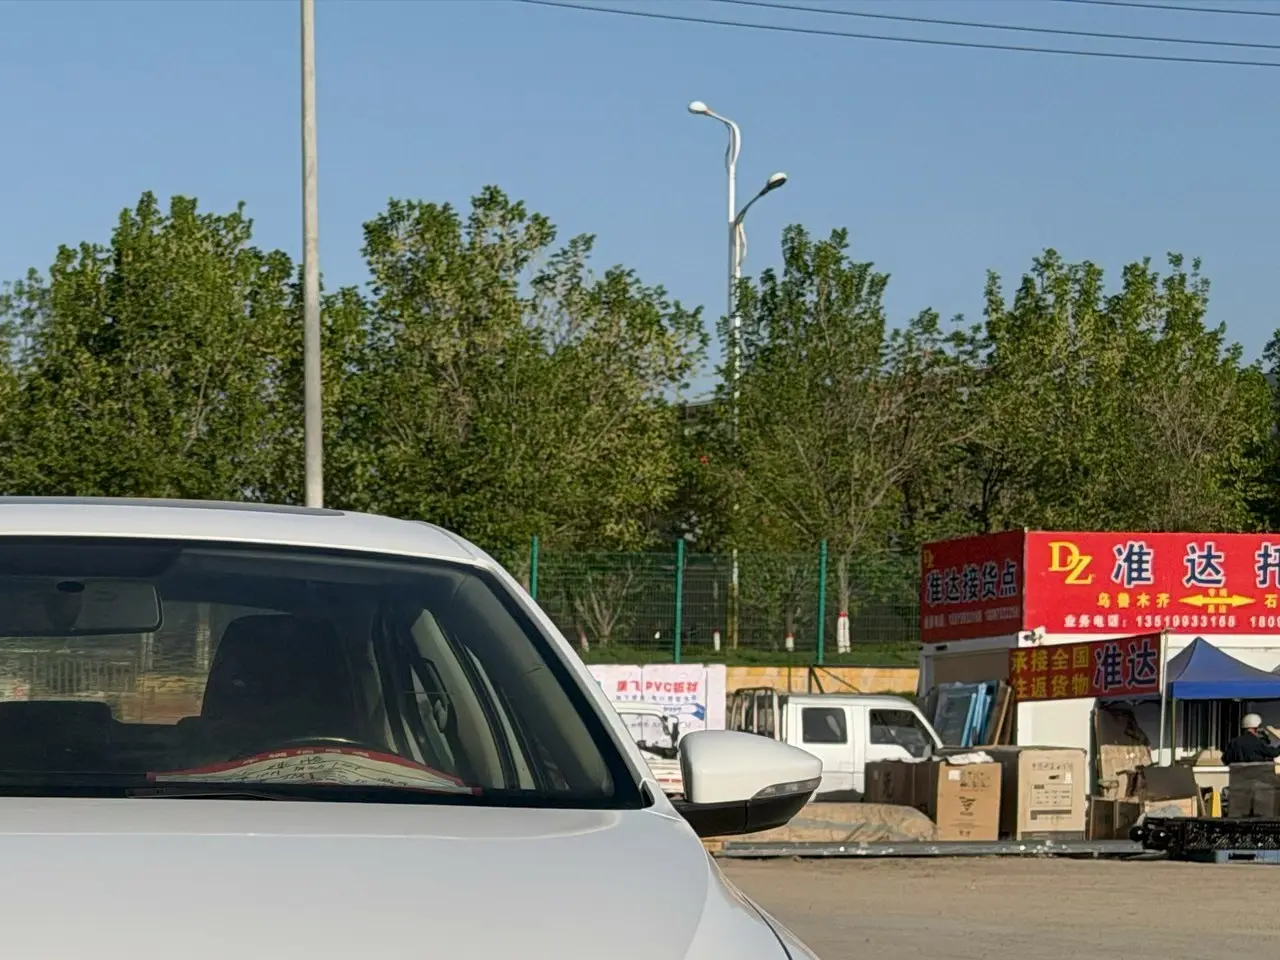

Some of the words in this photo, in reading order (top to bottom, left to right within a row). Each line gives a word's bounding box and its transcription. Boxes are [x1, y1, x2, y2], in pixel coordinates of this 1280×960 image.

[925, 559, 1017, 606] 准达接货点
[1048, 541, 1093, 584] DZ
[1097, 592, 1170, 608] 乌鲁木齐
[1011, 645, 1089, 672] 承接全国
[1094, 639, 1158, 692] 准达
